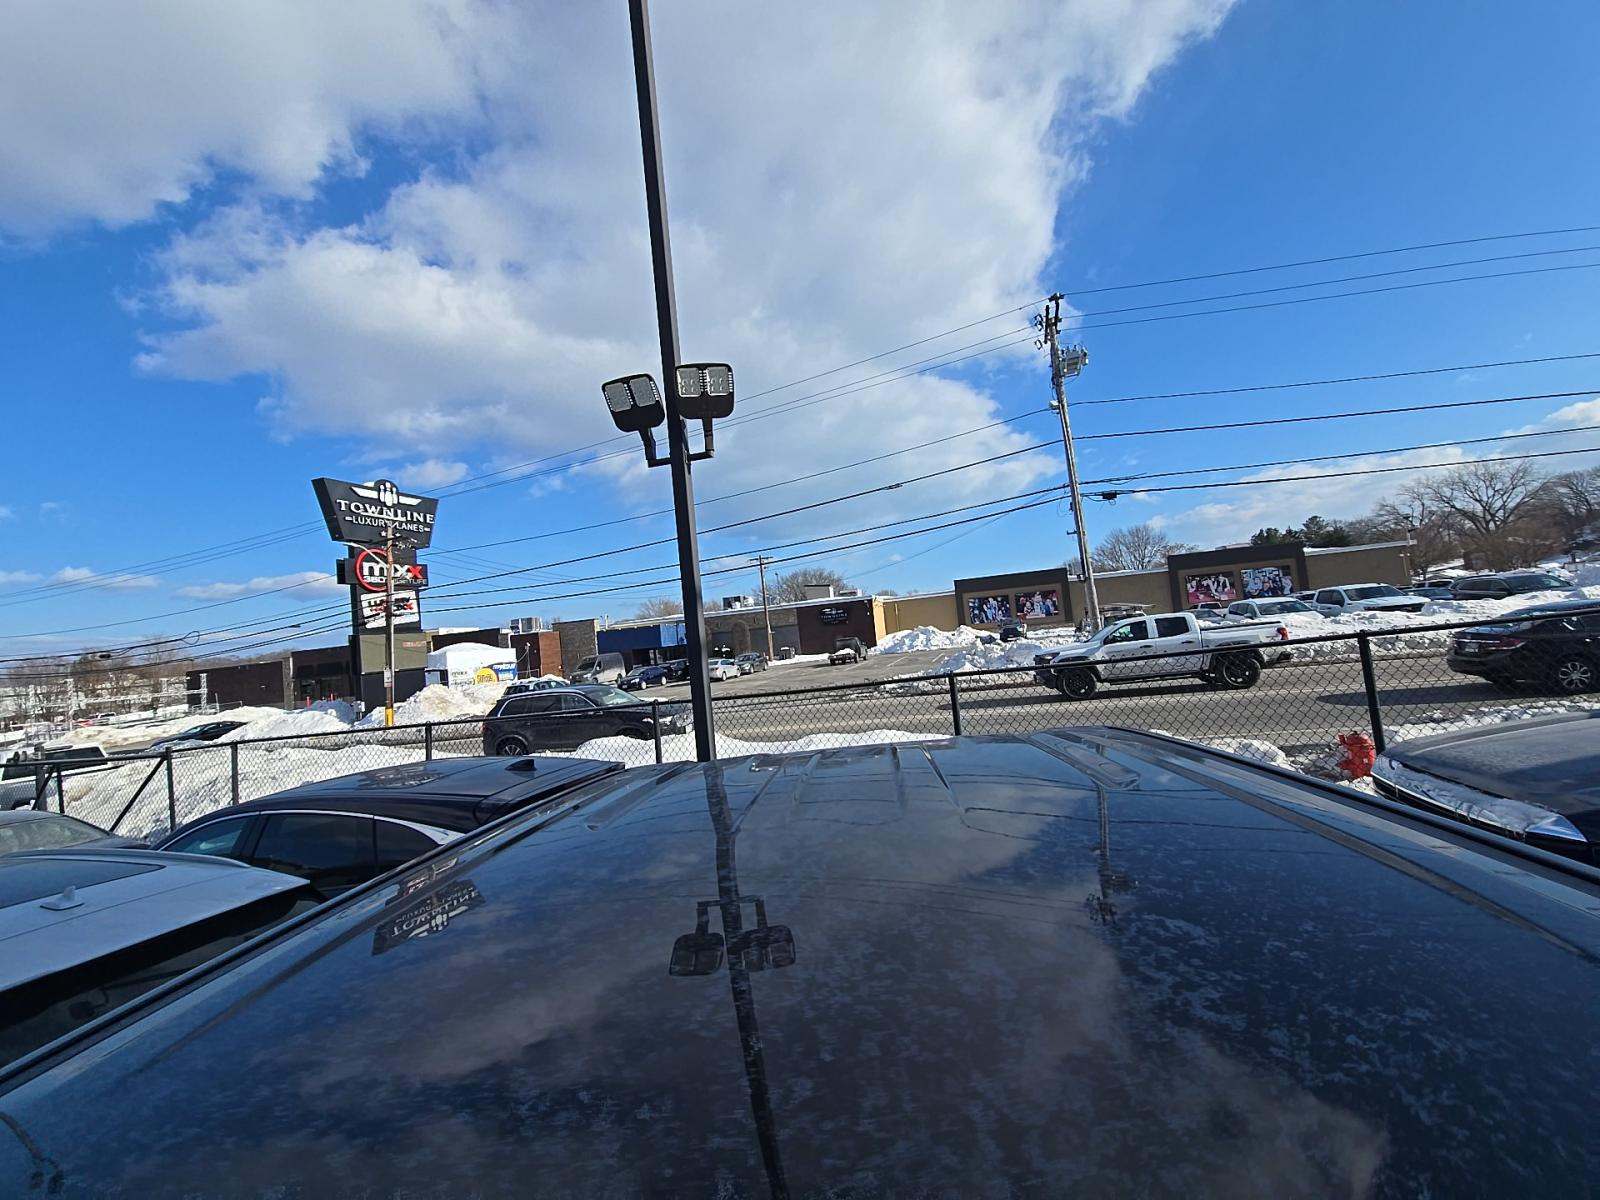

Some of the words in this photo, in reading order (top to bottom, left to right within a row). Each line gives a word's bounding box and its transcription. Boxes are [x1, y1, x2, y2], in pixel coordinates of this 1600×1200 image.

[336, 499, 435, 524] TOWNLINE
[396, 521, 424, 533] LANES
[362, 562, 424, 580] mxx
